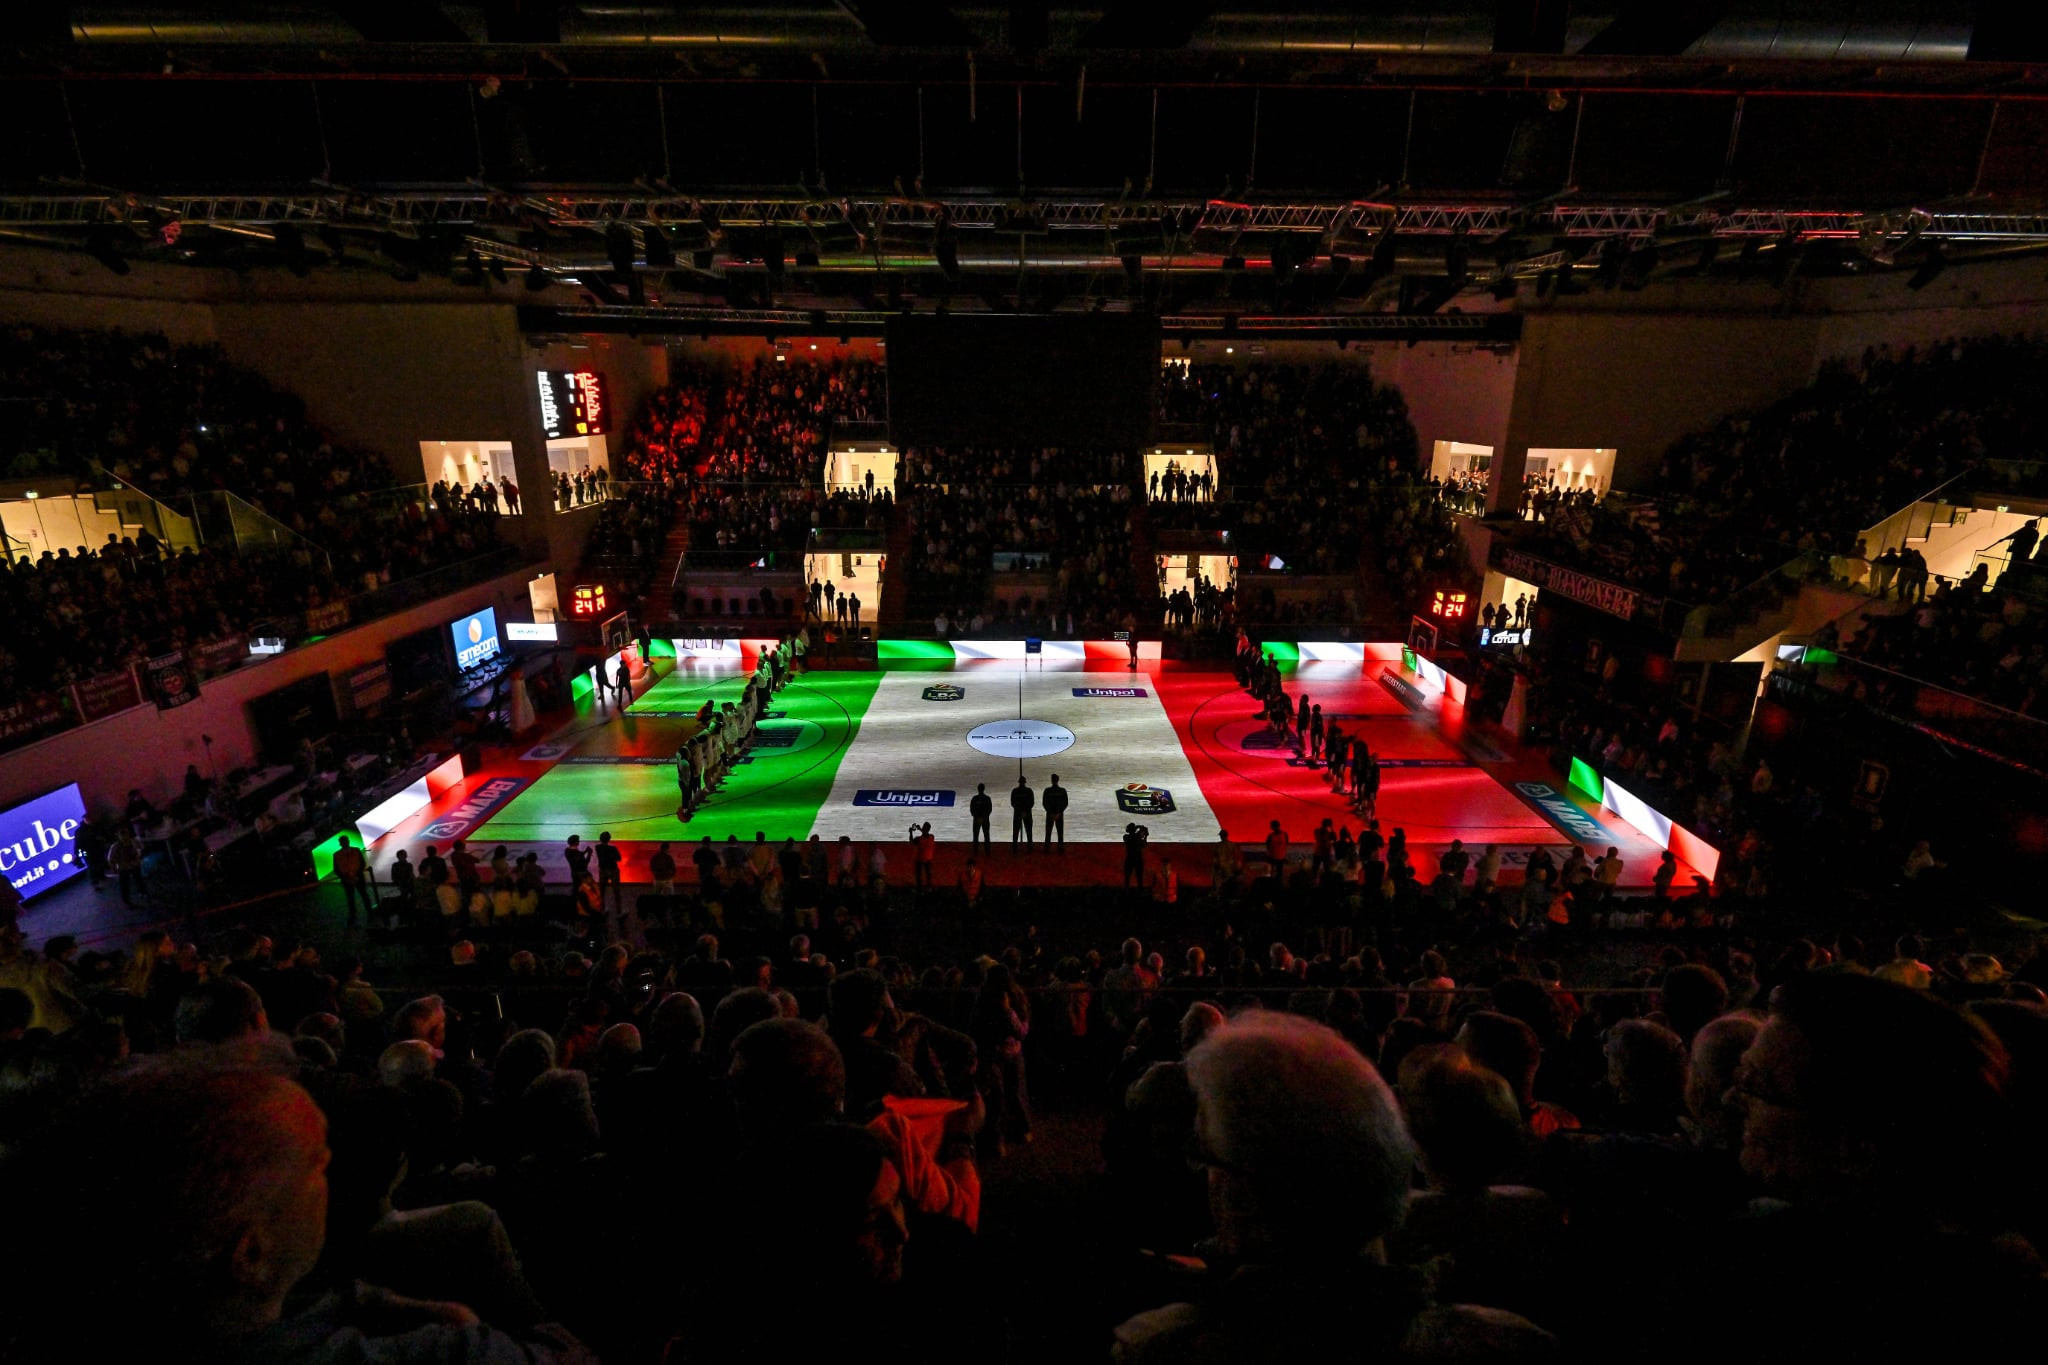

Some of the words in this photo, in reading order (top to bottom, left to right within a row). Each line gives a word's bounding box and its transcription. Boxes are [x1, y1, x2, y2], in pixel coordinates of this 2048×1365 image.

[575, 600, 593, 613] 24
[1445, 604, 1463, 616] 24
[1087, 688, 1136, 696] Unipol
[450, 780, 517, 819] MAPEI
[876, 791, 940, 804] Unipol
[0, 818, 78, 871] cube
